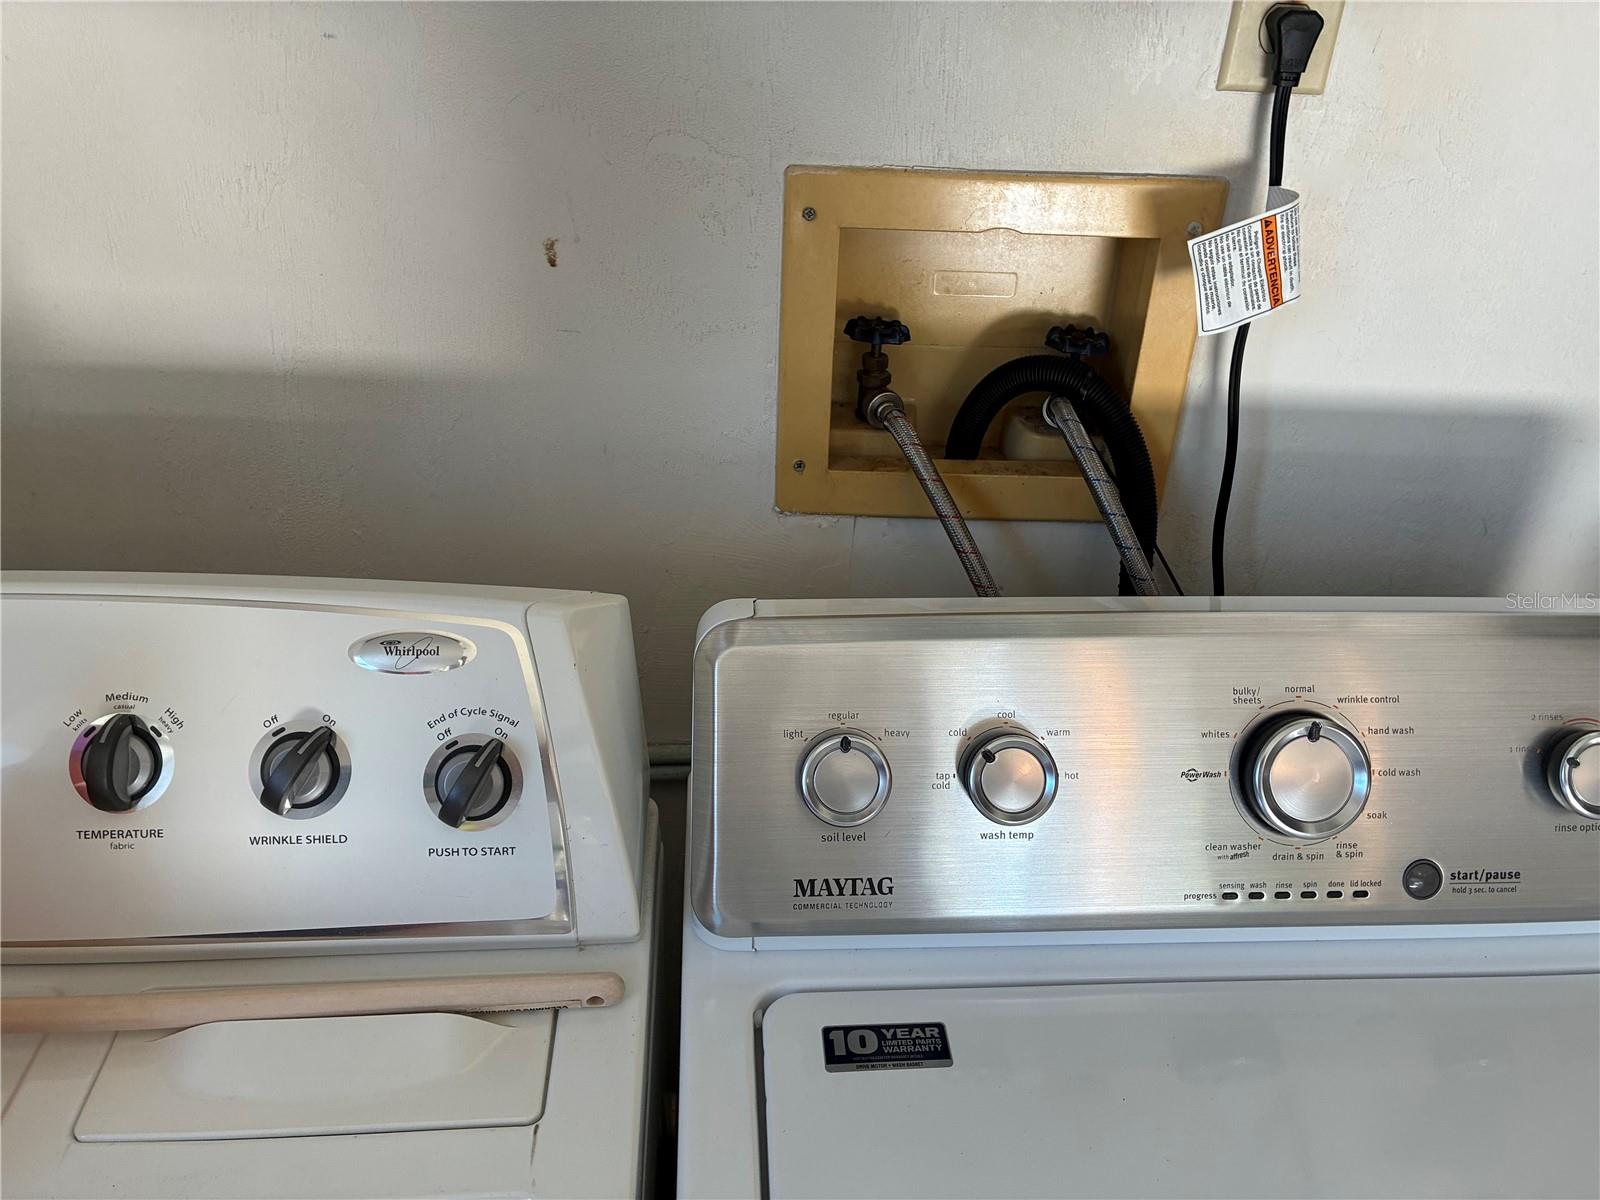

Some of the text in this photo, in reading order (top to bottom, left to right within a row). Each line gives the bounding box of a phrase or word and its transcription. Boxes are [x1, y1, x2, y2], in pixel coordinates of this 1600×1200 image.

[1266, 230, 1280, 306] ADVERTENCIA
[384, 645, 440, 659] Whirlpool
[1233, 687, 1260, 696] bulky/
[1285, 684, 1315, 693] normal
[105, 692, 149, 703] Medium
[1233, 695, 1262, 704] sheets
[1337, 695, 1400, 704] wrinkle control
[63, 708, 82, 727] Low
[164, 707, 185, 730] High
[322, 714, 337, 727] On
[427, 707, 520, 729] End of Cycle Signal
[828, 712, 859, 721] regular
[1538, 713, 1564, 721] rinses
[73, 718, 88, 732] knits
[158, 717, 174, 734] heavy
[262, 714, 280, 729] Off
[494, 727, 509, 739] On
[784, 730, 804, 739] light
[884, 728, 910, 738] heavy
[948, 728, 968, 736] cold
[1046, 728, 1070, 736] warm
[1201, 730, 1230, 738] whites
[1368, 726, 1415, 734] hand wash
[437, 728, 452, 742] Off
[936, 772, 950, 782] tap
[1064, 772, 1079, 780] hot
[1181, 771, 1222, 779] PowerWash
[1378, 768, 1421, 777] cold wash
[932, 782, 950, 790] cold
[1367, 811, 1388, 820] soak
[1554, 824, 1577, 832] rinse
[76, 829, 164, 840] TEMPERATURE
[821, 832, 866, 842] soil level
[980, 831, 1034, 841] wash temp
[249, 834, 348, 846] WRINKLE SHIELD
[110, 842, 135, 850] fabric
[1205, 842, 1262, 851] clean washer
[428, 846, 516, 857] PUSH TO START
[1230, 851, 1250, 860] affresh
[1336, 849, 1363, 859] & spin
[1272, 852, 1294, 861] drain
[1305, 852, 1324, 863] spin
[1450, 869, 1521, 882] start/pause
[793, 877, 894, 898] MAYTAG
[1219, 881, 1245, 890] sensing
[1250, 880, 1267, 888] wash
[1276, 880, 1293, 888] rinse
[1303, 880, 1318, 888] spin
[1360, 879, 1382, 887] locked
[1184, 892, 1217, 901] progress
[792, 902, 842, 910] COMMERCIAL
[880, 1027, 940, 1039] YEAR
[829, 1029, 878, 1056] 10
[883, 1044, 942, 1053] WARRANTY
